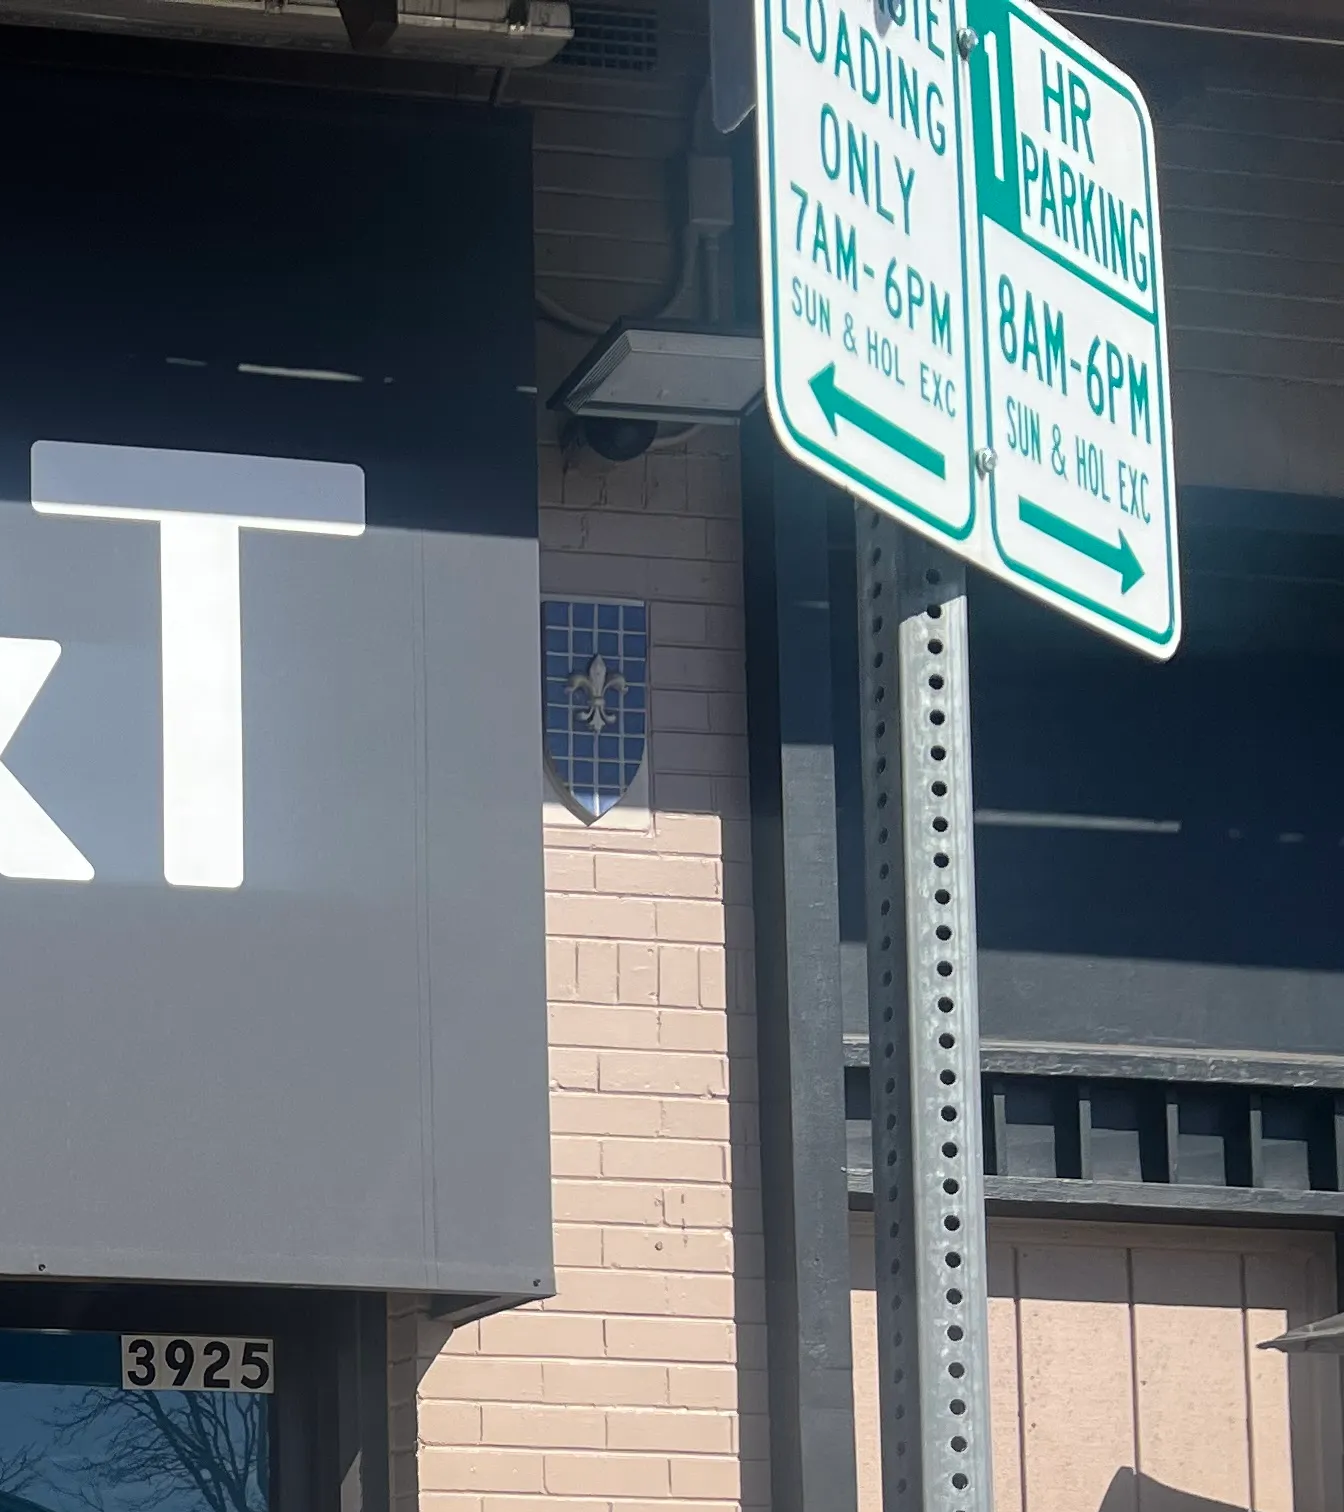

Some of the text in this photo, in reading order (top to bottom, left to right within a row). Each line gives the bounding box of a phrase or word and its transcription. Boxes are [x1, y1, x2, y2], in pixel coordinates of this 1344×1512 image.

[781, 0, 945, 156] LOADING
[983, 30, 1005, 182] 1
[1040, 48, 1095, 165] HR
[820, 103, 915, 236] ONLY
[1020, 131, 1148, 293] PARKING
[792, 276, 956, 418] SUN & HOL EXC
[998, 273, 1151, 445] 8AM-6PM
[1006, 395, 1151, 524] SUN & HOL EXC
[127, 1339, 270, 1389] 3925
